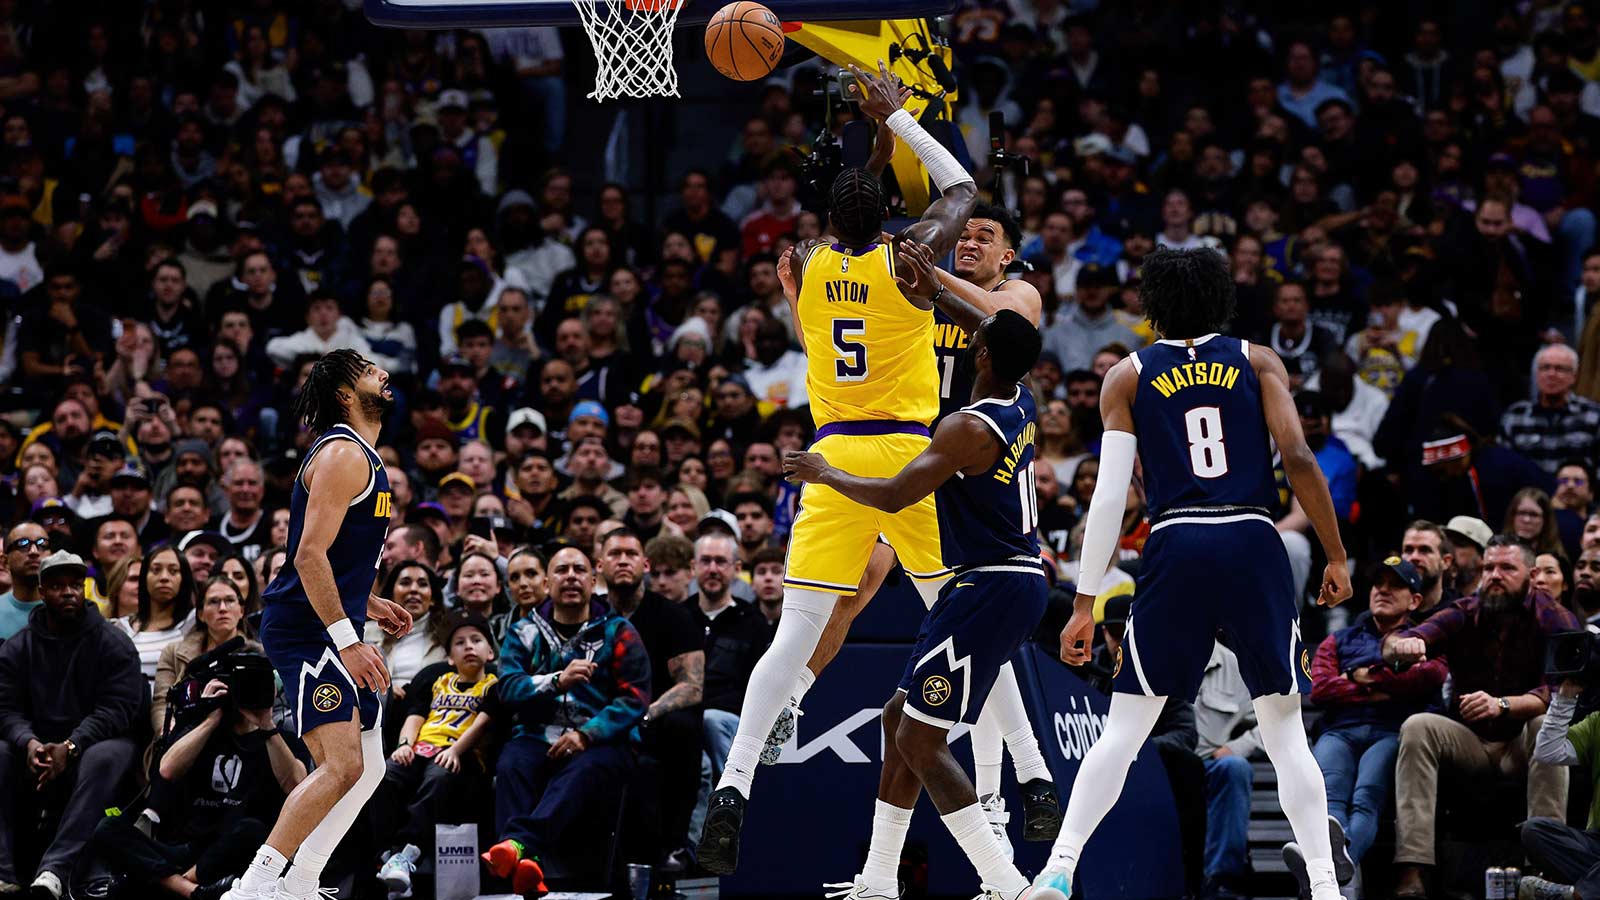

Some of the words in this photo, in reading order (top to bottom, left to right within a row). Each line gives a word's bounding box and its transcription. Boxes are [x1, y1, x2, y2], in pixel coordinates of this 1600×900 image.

[825, 280, 869, 304] AYTON
[832, 318, 869, 382] 5
[936, 355, 955, 399] 1
[1150, 361, 1241, 399] WATSON
[1184, 405, 1229, 479] 8
[1017, 460, 1039, 535] 10
[430, 693, 481, 712] LAKERS
[438, 846, 474, 855] UMB
